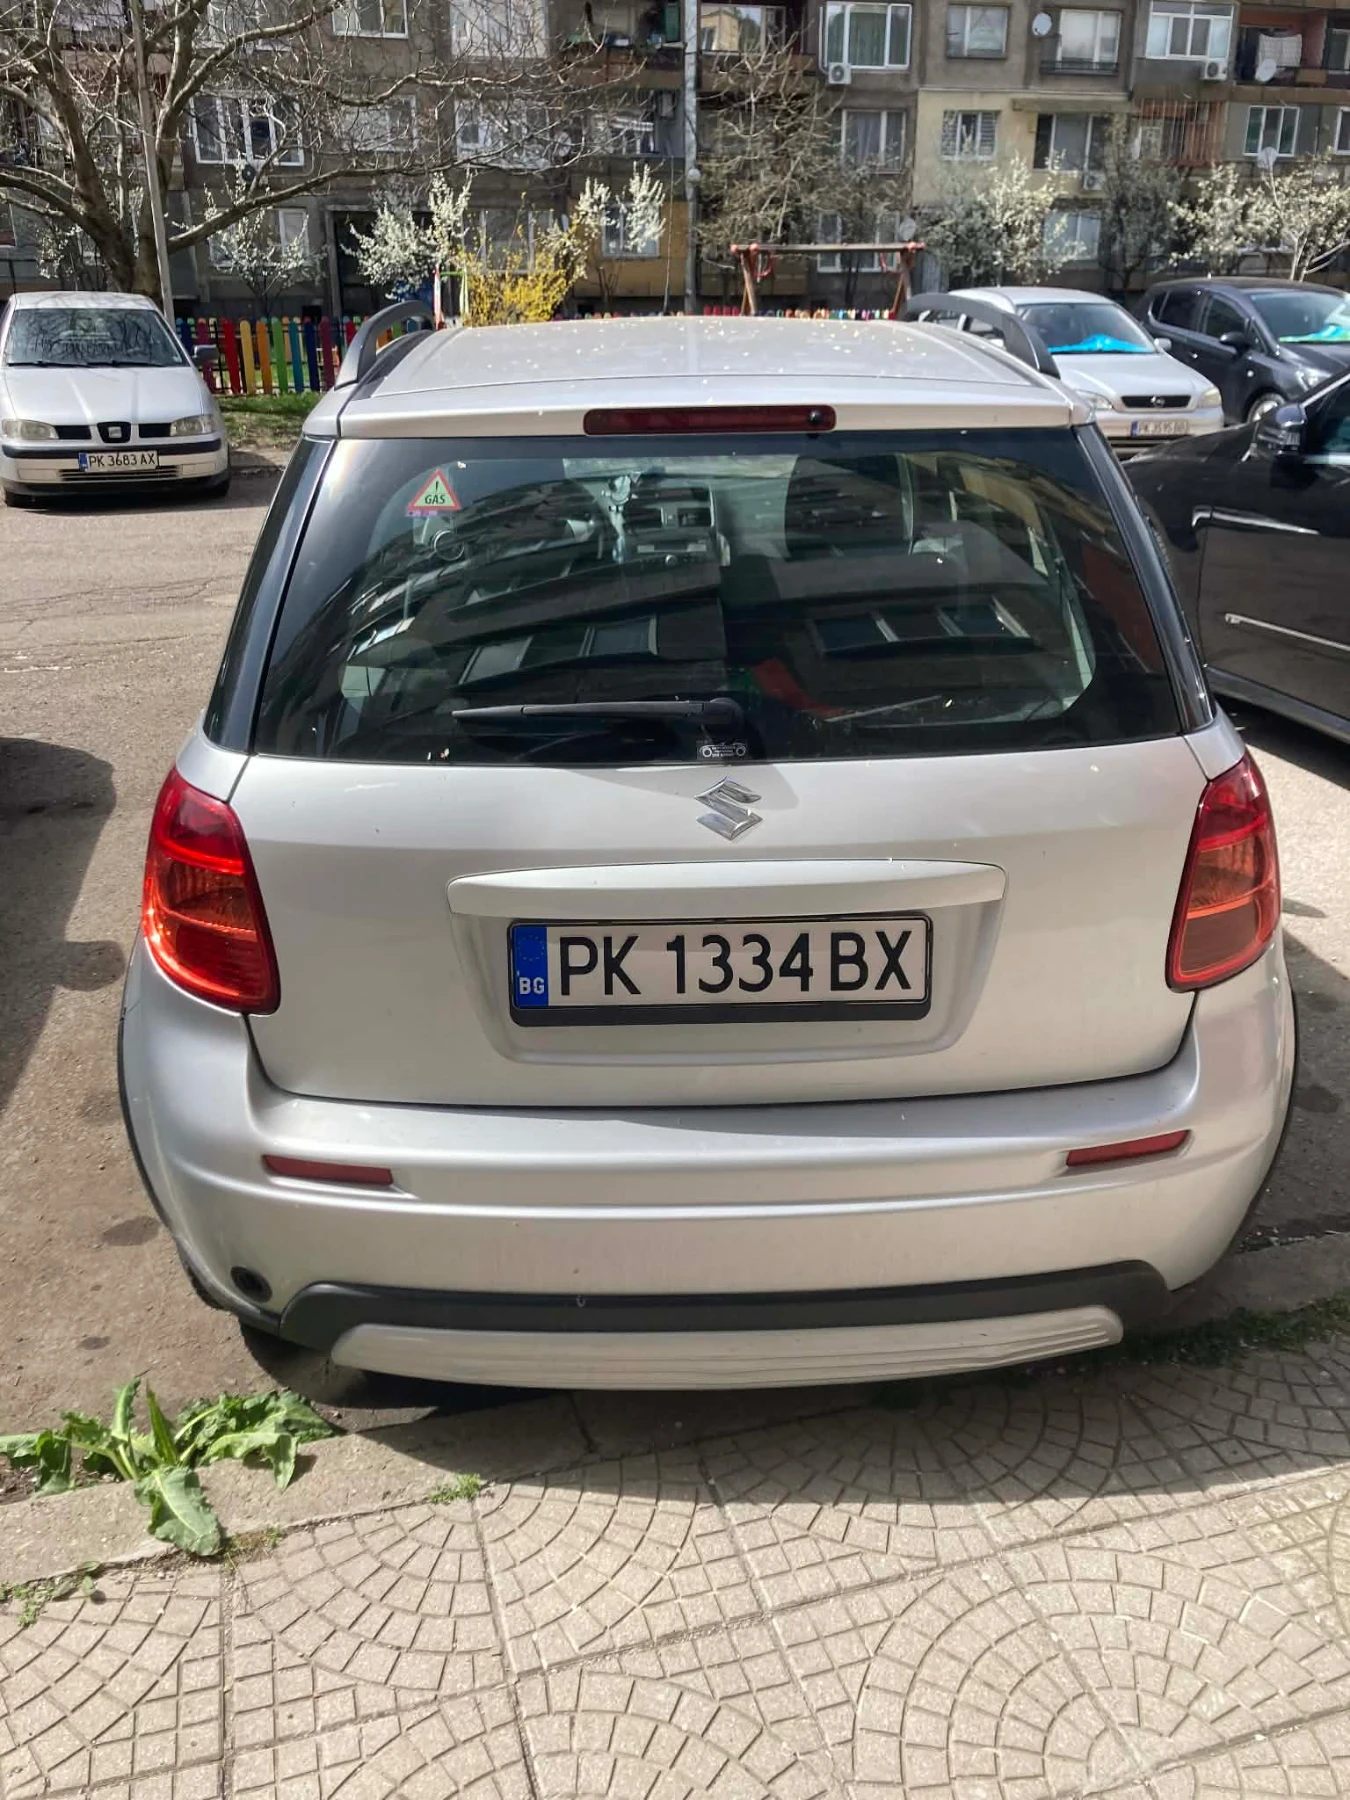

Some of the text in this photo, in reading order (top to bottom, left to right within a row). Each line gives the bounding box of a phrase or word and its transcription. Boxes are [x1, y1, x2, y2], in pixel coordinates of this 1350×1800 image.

[89, 455, 105, 467] PK
[140, 453, 155, 465] AX
[424, 494, 446, 505] GAS
[559, 930, 913, 996] PK 1334 BX
[519, 977, 545, 995] BG
